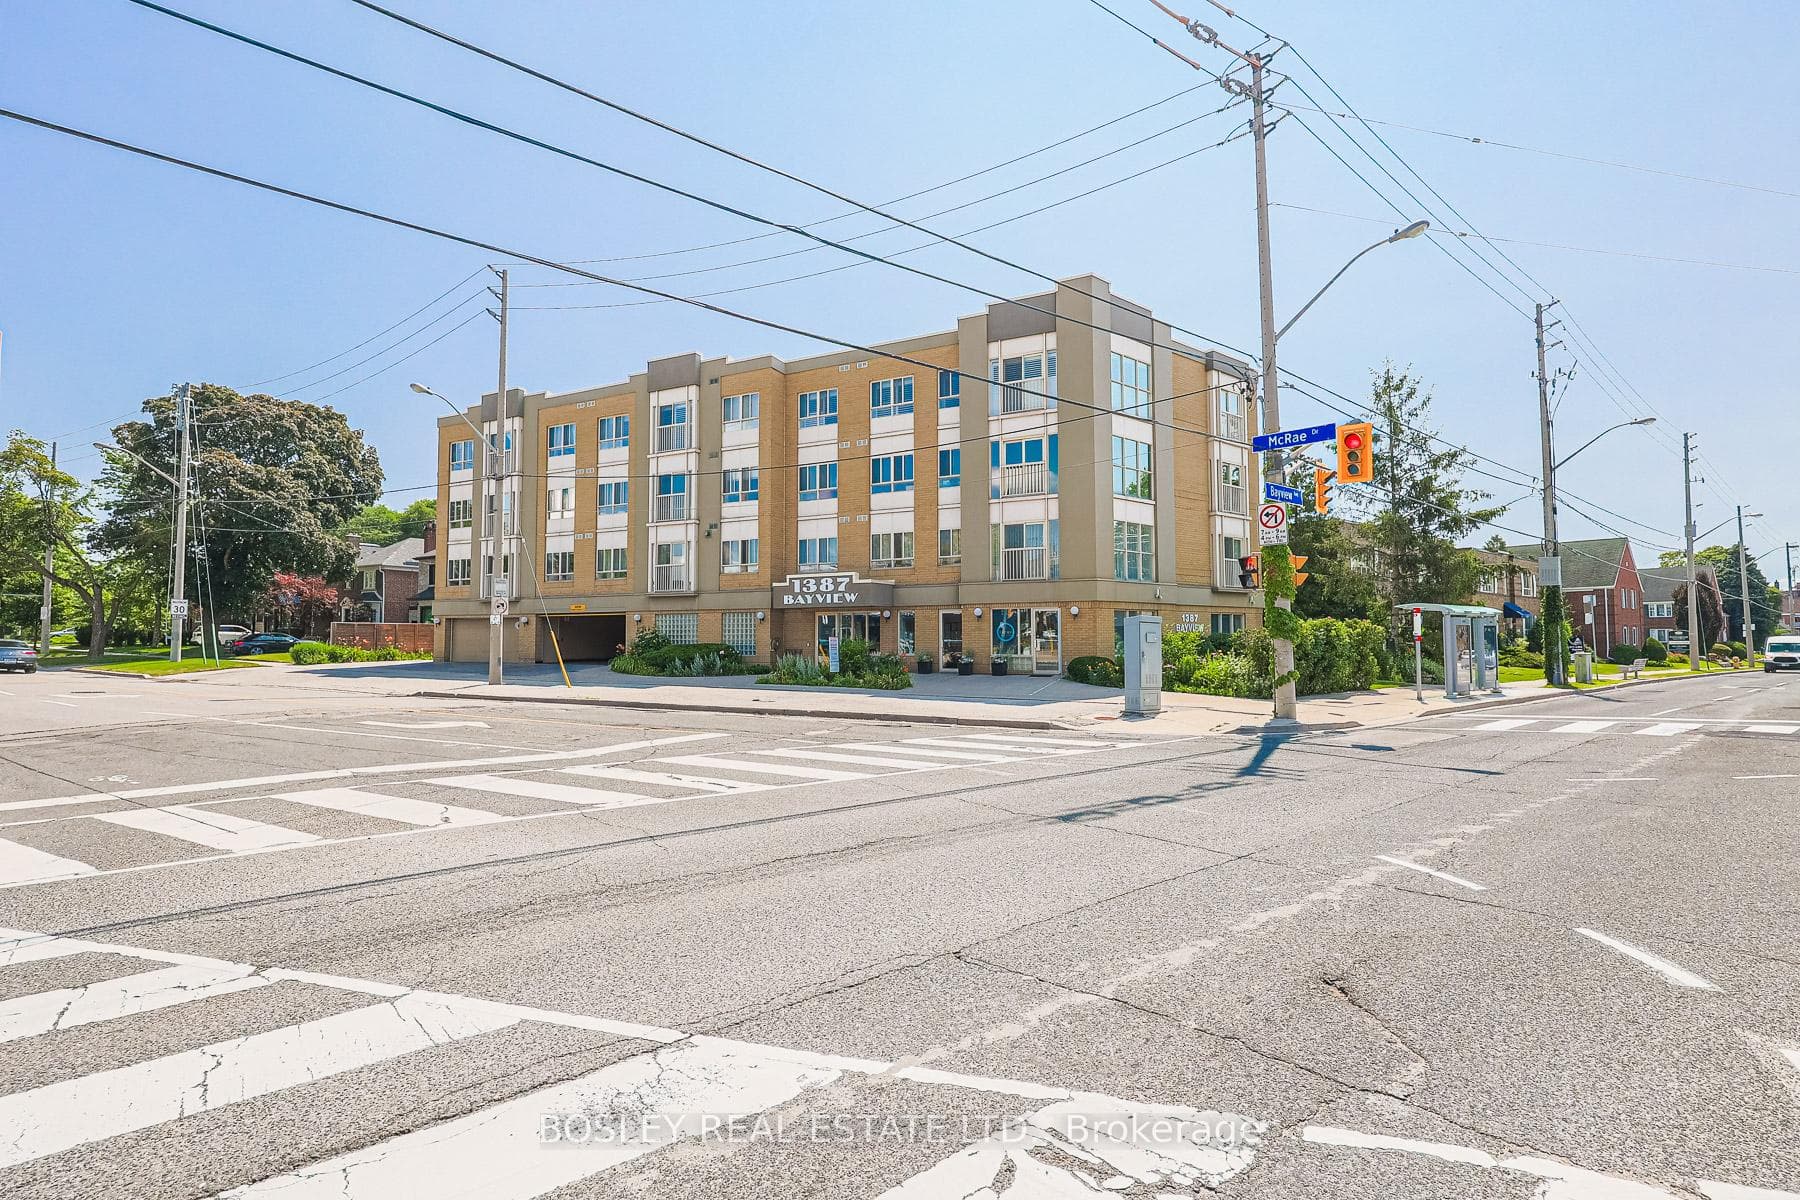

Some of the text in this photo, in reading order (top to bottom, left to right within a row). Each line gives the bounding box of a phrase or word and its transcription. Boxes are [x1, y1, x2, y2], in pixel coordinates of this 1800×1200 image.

[1268, 432, 1307, 447] McRae
[1270, 486, 1293, 500] Bayview
[792, 577, 850, 592] 1387
[784, 592, 858, 604] BAYVIEW
[1182, 614, 1198, 622] 1387
